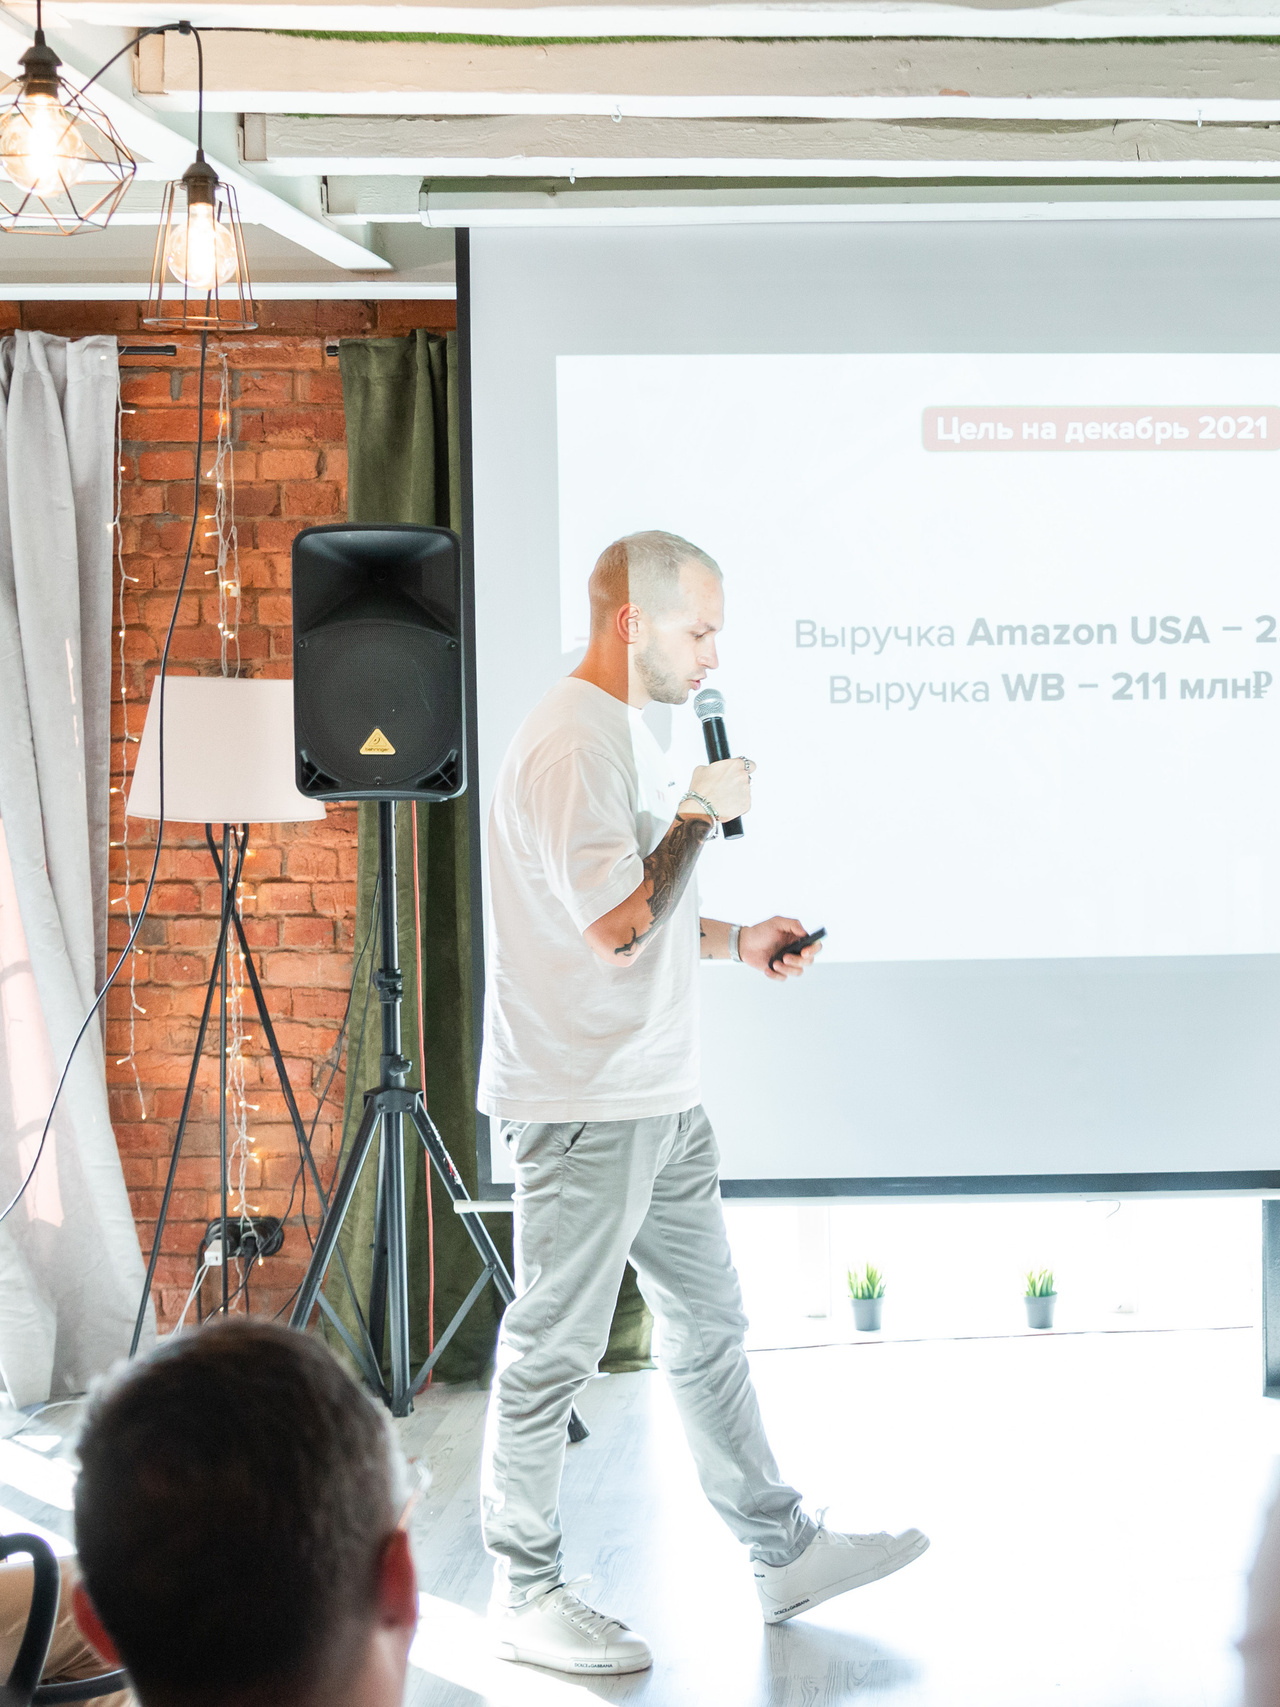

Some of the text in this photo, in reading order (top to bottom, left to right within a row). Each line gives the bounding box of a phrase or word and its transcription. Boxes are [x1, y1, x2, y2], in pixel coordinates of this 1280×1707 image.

[936, 415, 1267, 445] Цель на декабрь 2021
[795, 619, 955, 655] Выручка
[966, 617, 1118, 647] Amazon
[1131, 616, 1211, 645] USA
[829, 675, 990, 711] Выручка
[1001, 673, 1066, 702] WB
[1112, 672, 1167, 701] 211
